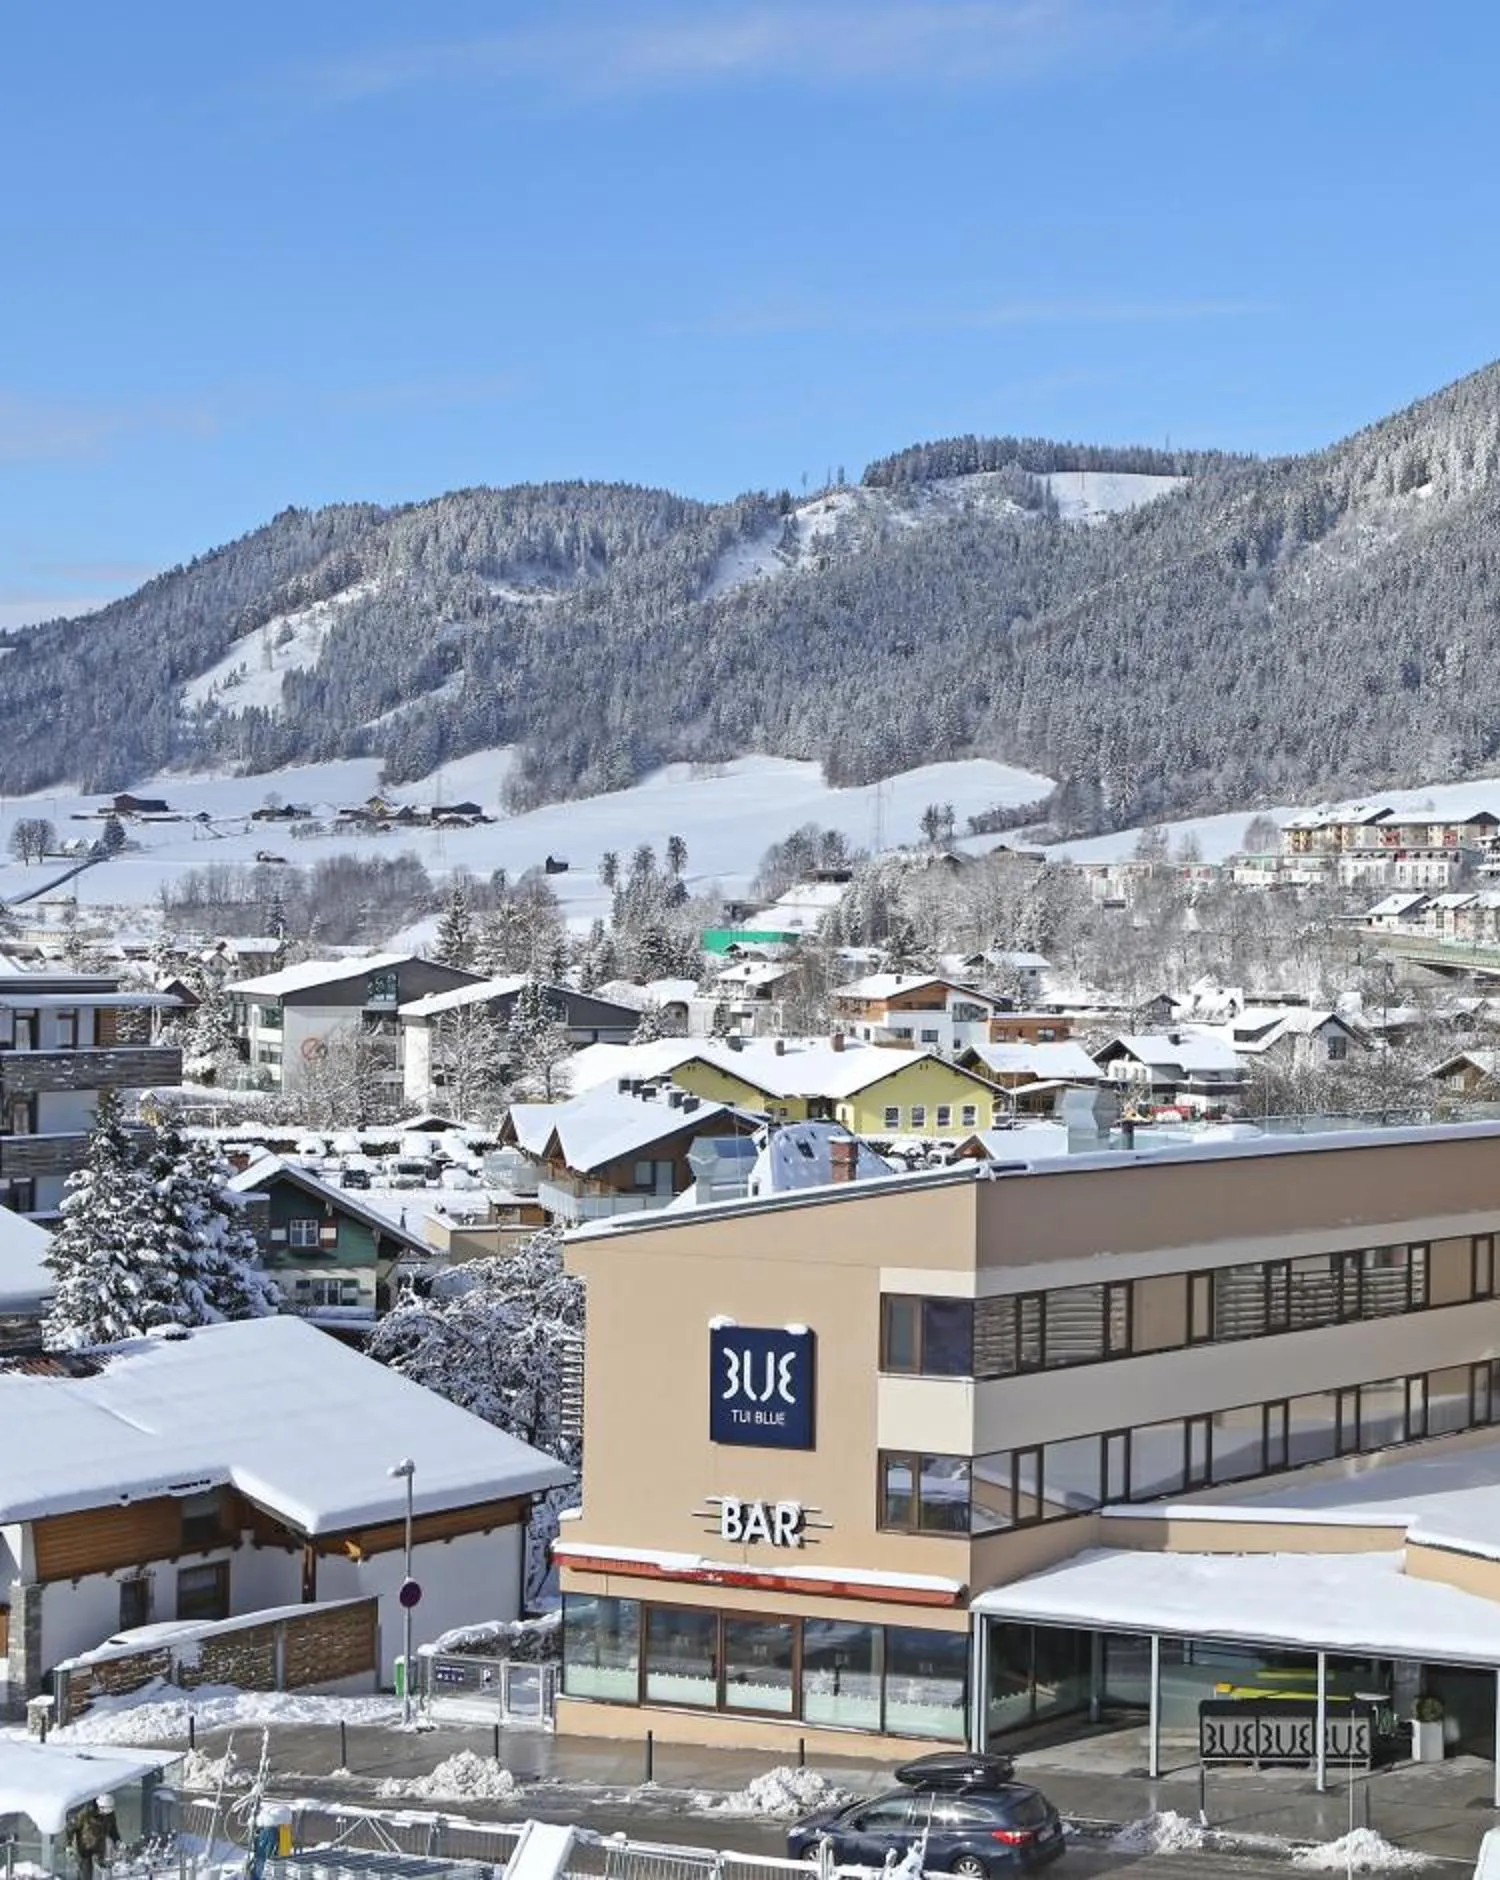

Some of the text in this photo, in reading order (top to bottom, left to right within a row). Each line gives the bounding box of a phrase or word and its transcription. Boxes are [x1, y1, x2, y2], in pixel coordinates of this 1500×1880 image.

[731, 1409, 785, 1425] TUI BLUE
[720, 1500, 804, 1548] BAR
